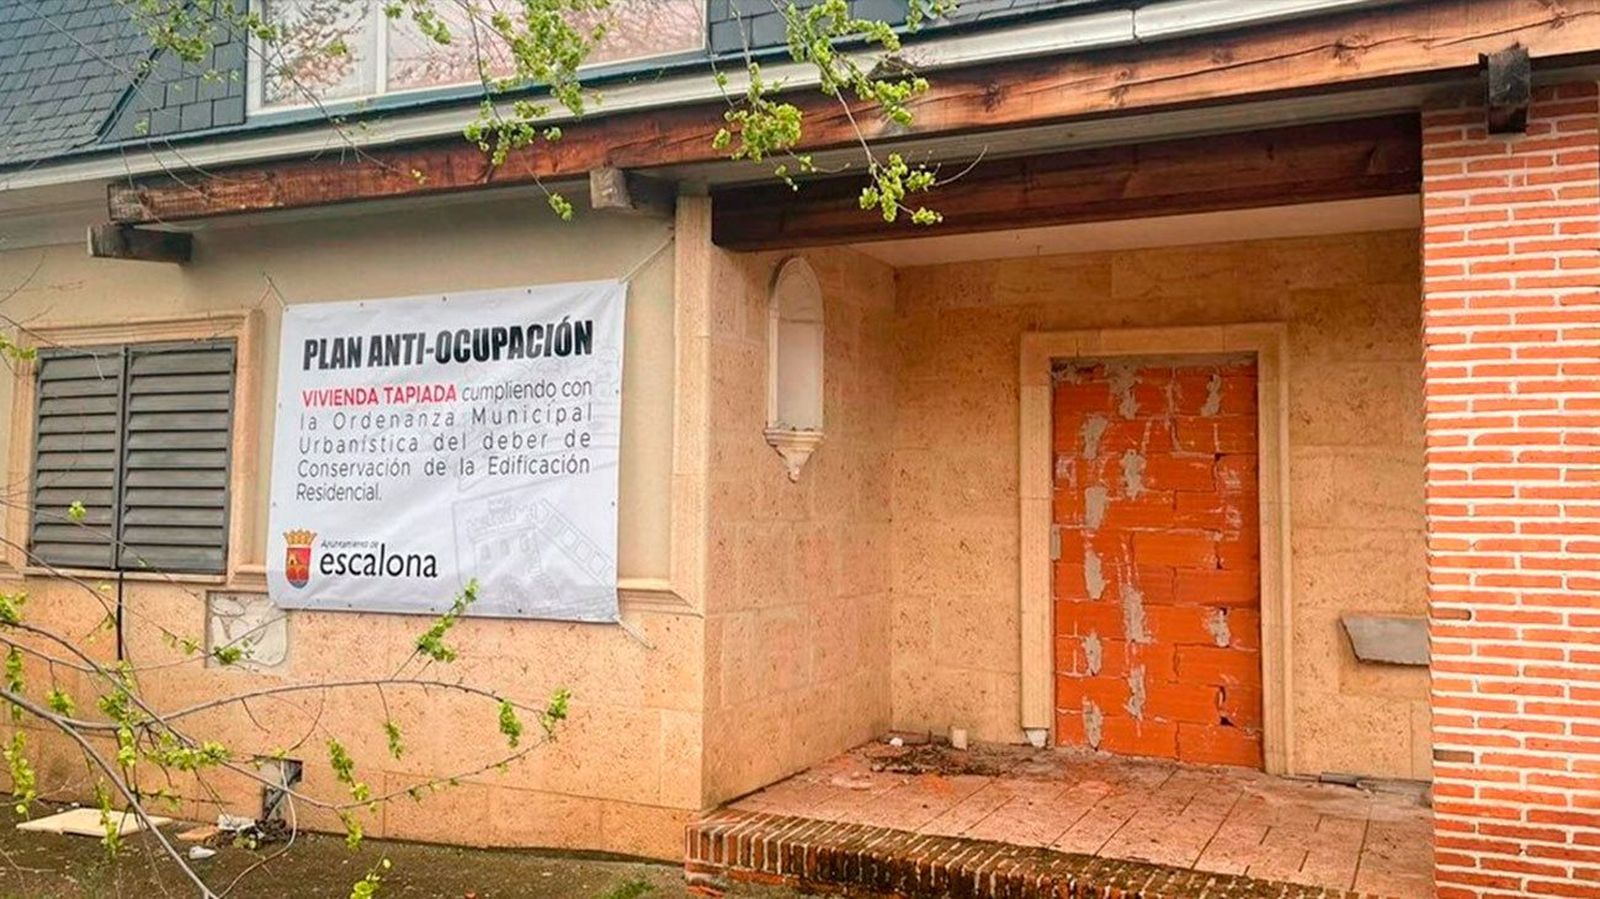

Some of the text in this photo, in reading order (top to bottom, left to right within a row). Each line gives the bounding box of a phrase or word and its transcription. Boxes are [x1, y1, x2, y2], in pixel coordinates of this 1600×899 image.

[303, 315, 593, 370] PLAN ANTI-OCUPACIÓN
[302, 379, 591, 407] VIVIENDA TAPIADA cumpliendo con
[301, 403, 592, 430] la Ordenanza Municipal
[300, 430, 591, 453] Urbanística del deber de
[298, 454, 590, 478] Conservación de la Edificación
[296, 484, 382, 501] Residencial.
[319, 544, 438, 578] escalona
